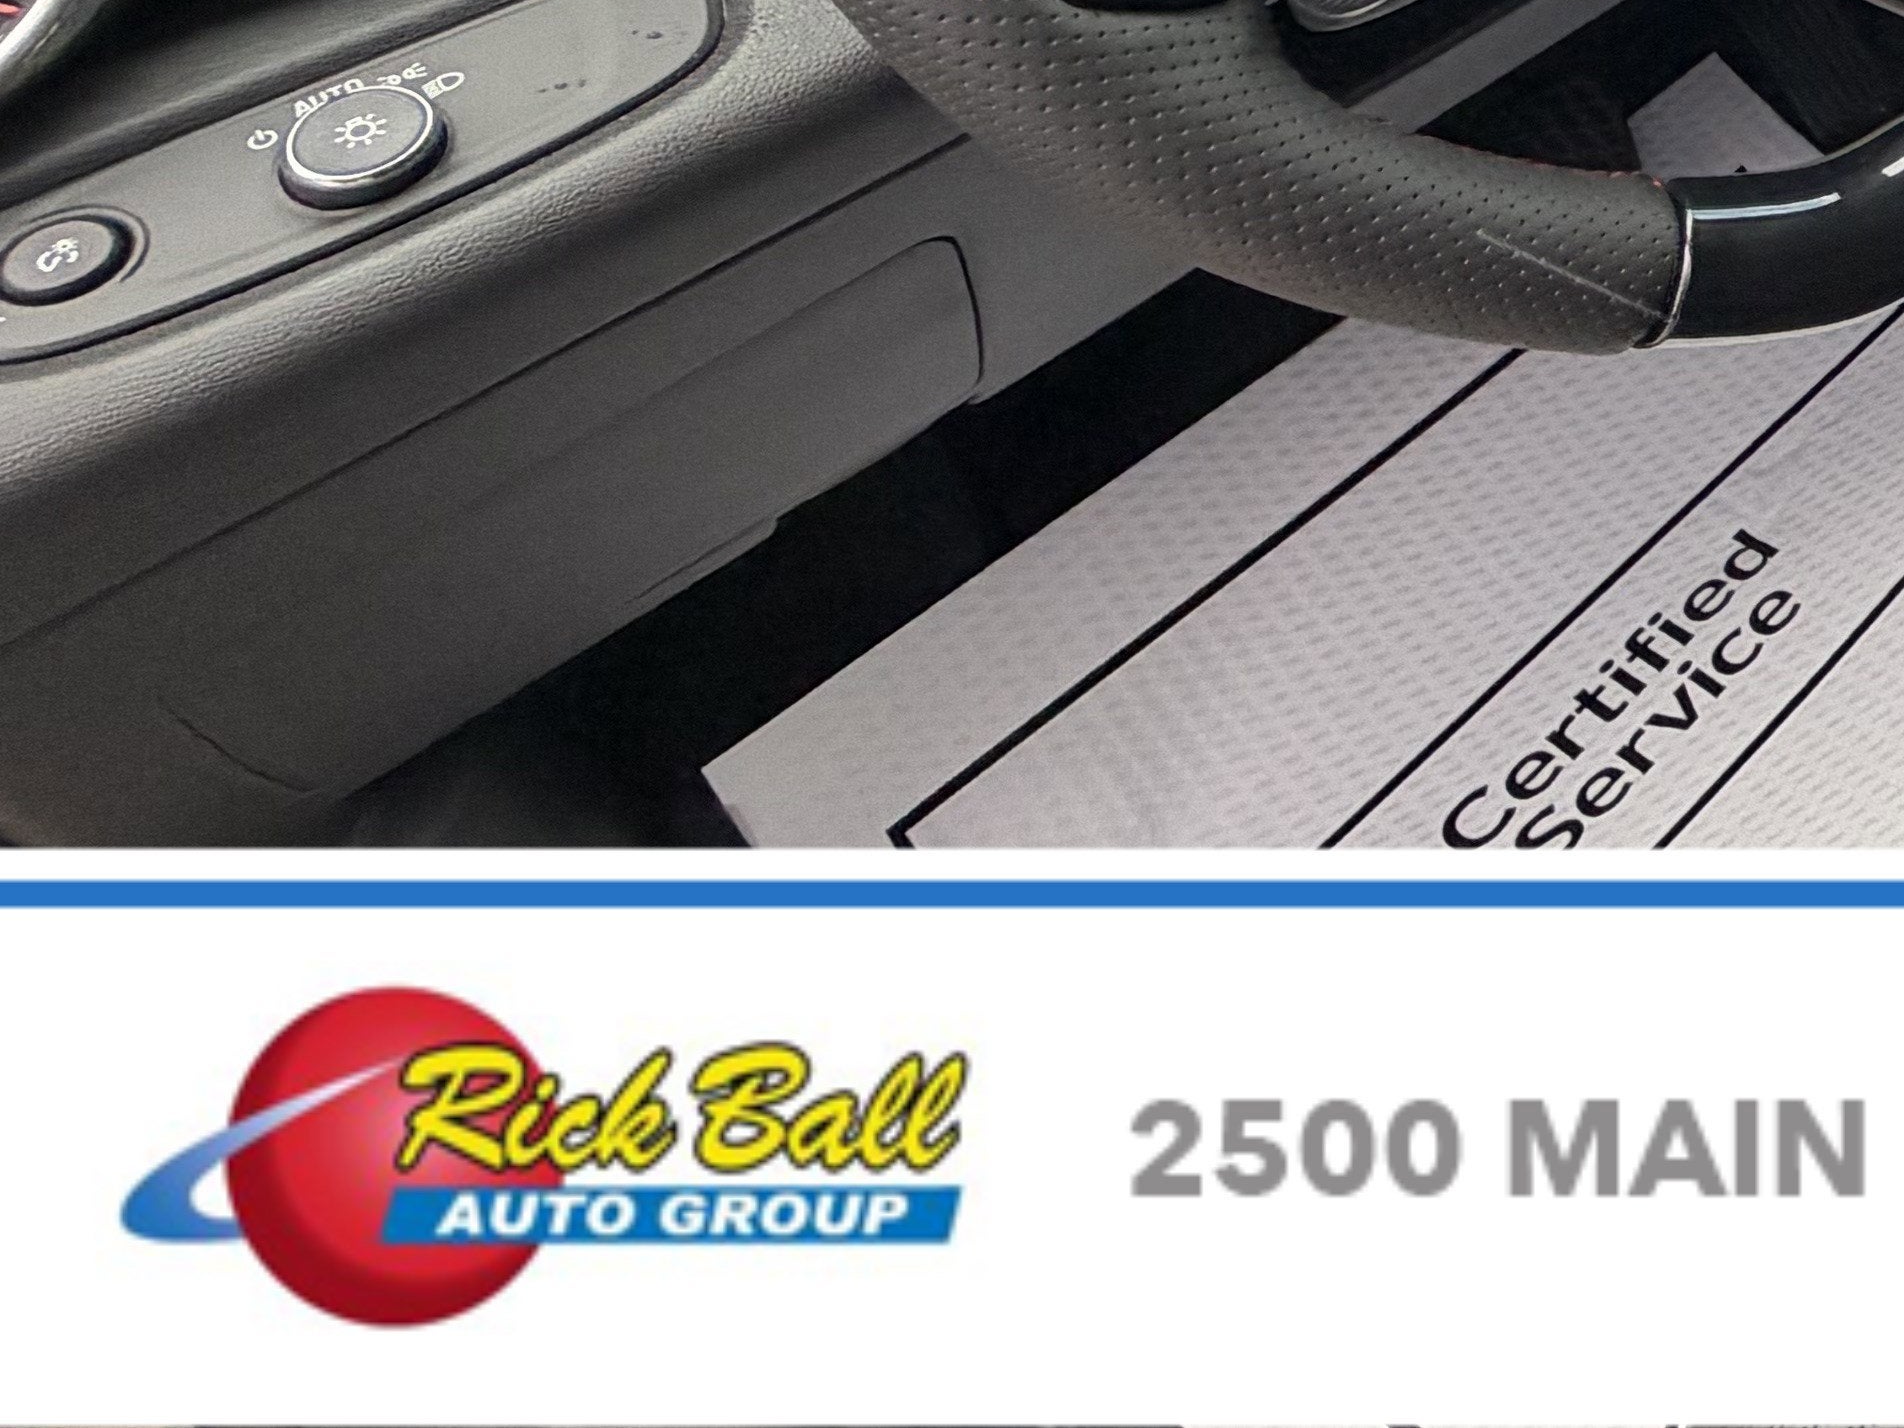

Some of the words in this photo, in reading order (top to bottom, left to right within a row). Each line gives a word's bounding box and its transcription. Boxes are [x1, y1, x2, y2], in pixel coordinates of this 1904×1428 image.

[293, 78, 365, 118] AUTO
[1442, 528, 1780, 850] Certified
[1514, 590, 1801, 850] Service
